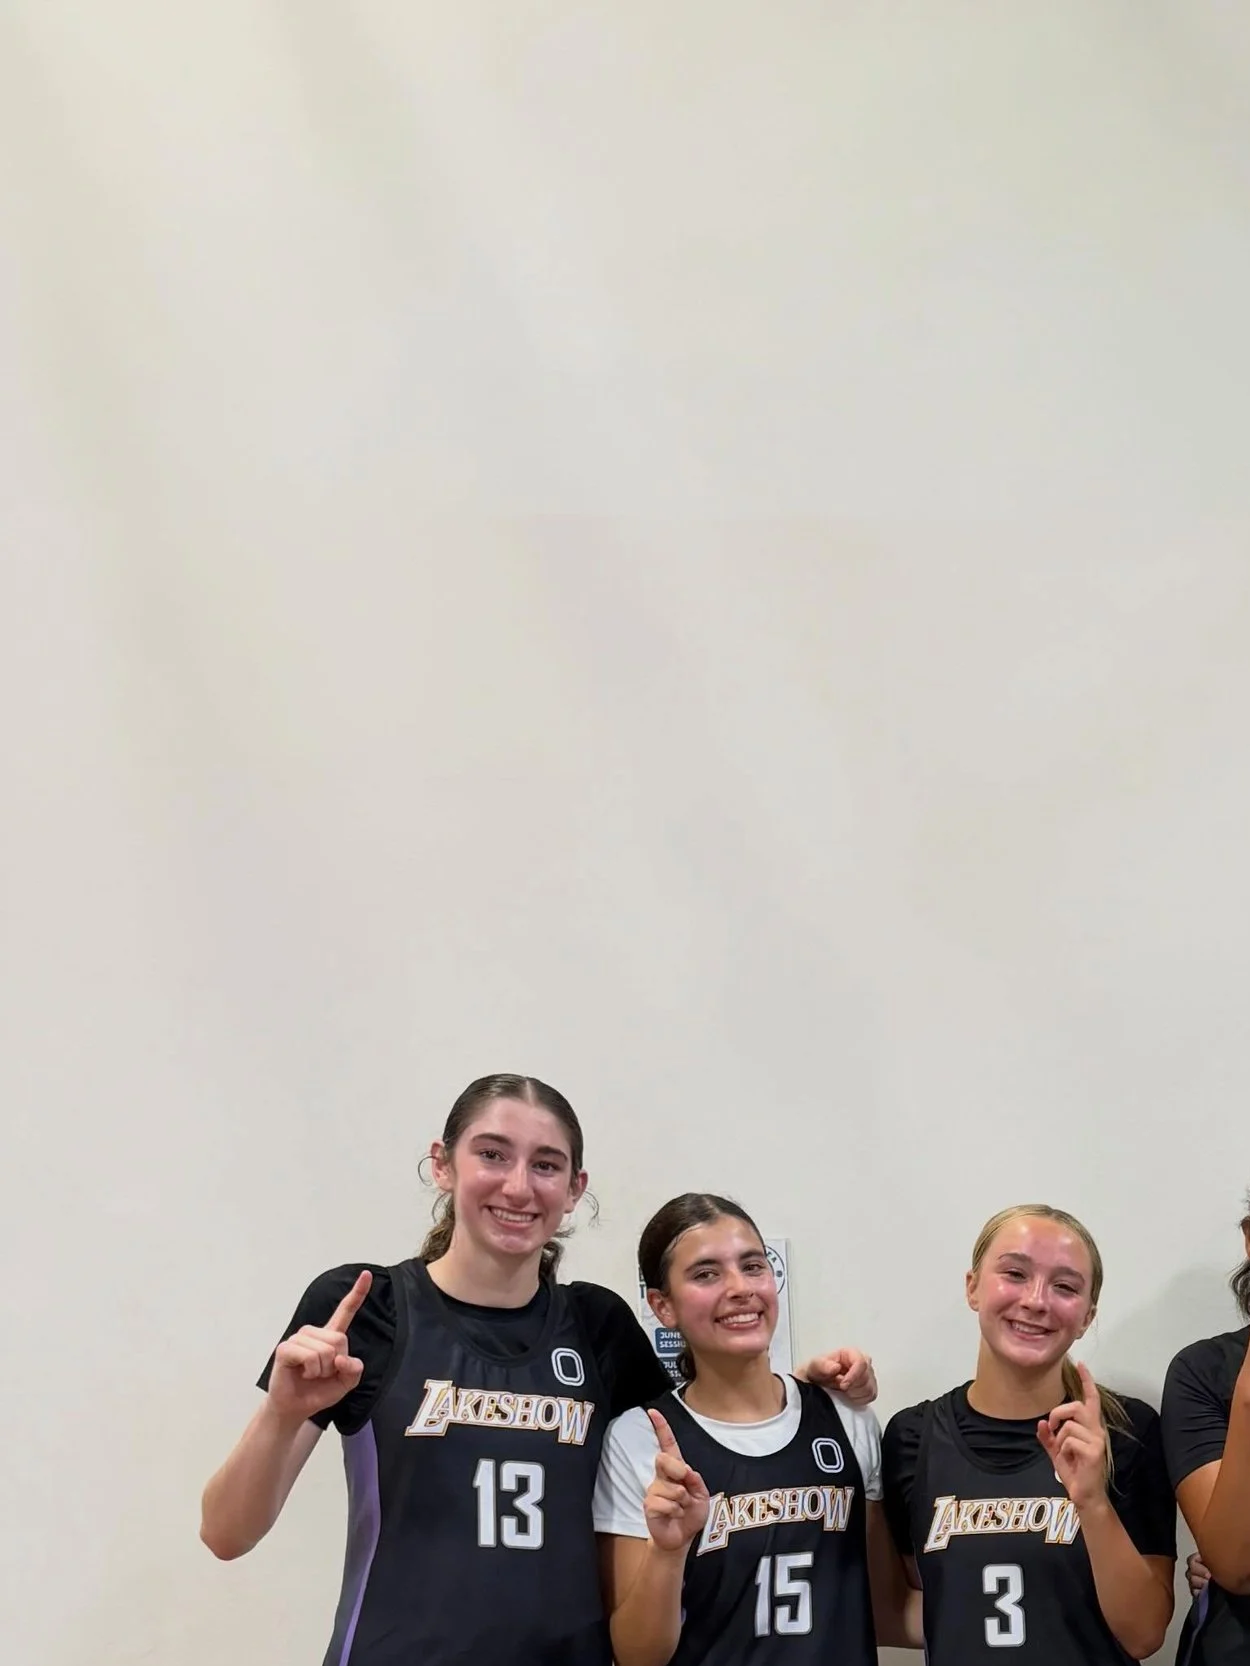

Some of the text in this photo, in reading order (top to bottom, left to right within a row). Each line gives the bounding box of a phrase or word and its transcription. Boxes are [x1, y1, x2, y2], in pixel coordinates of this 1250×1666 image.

[659, 1340, 687, 1348] SESSIO
[404, 1378, 595, 1446] LAKESHOW
[472, 1458, 545, 1550] 13
[696, 1485, 855, 1557] LAKESHOW
[923, 1495, 1082, 1554] LAKESHOW
[754, 1551, 814, 1638] 15
[982, 1563, 1026, 1648] 3
